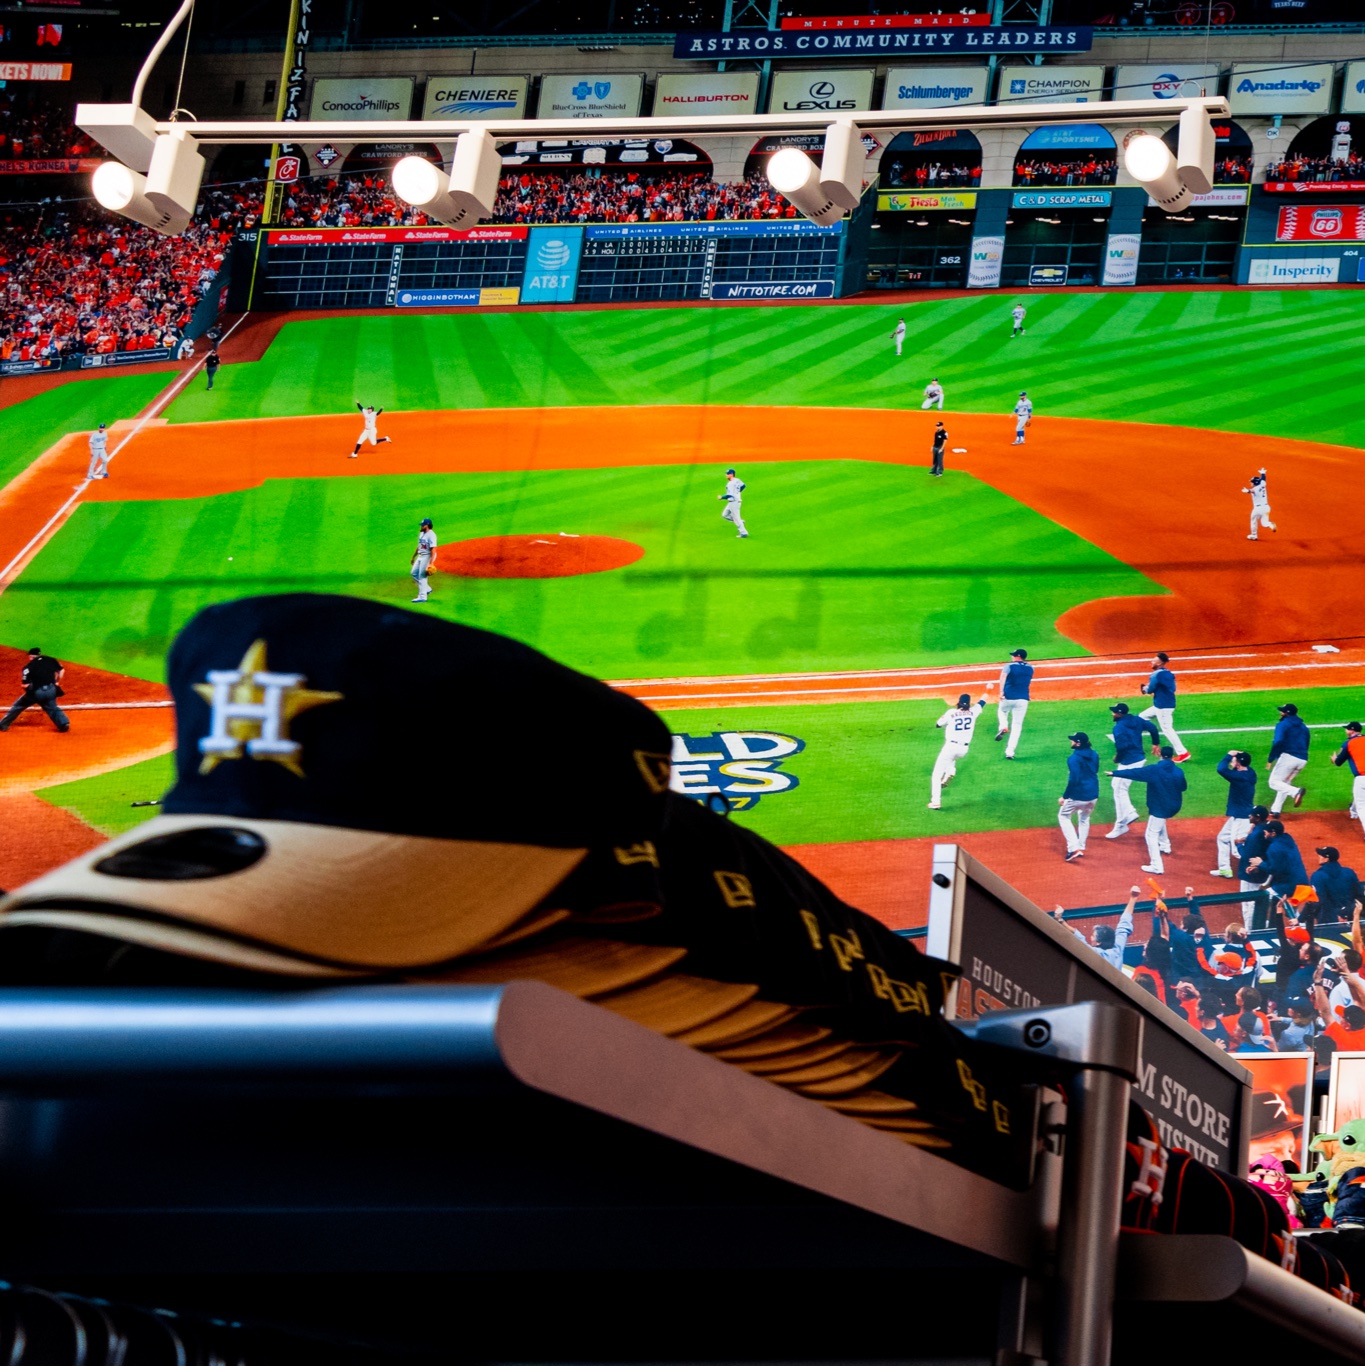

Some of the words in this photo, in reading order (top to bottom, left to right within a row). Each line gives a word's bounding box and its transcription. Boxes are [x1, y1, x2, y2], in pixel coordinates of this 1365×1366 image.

[804, 18, 892, 28] MINUTE
[914, 16, 970, 26] MAID
[690, 36, 783, 51] ASTROS
[796, 32, 955, 49] COMMUNITY
[966, 31, 1077, 46] LEADERS
[30, 63, 63, 80] NOW!
[1027, 79, 1091, 89] CHAMPION
[1152, 83, 1181, 91] OXY
[1236, 79, 1321, 93] Anadarko
[434, 89, 519, 102] CHENIERE
[662, 94, 749, 103] HALLIBURTON
[898, 85, 973, 101] Schlumberger
[322, 98, 400, 113] ConocoPhillips
[552, 103, 587, 111] BlueCross
[588, 103, 626, 111] BlueShield
[783, 100, 856, 111] LEXUS
[780, 136, 819, 144] LANDRY'S
[1052, 136, 1101, 144] SPORTSNET
[910, 196, 939, 208] Fiesta
[1019, 195, 1028, 205] C
[1037, 195, 1046, 205] D
[1049, 194, 1076, 204] SCRAP
[1078, 194, 1105, 204] METAL
[1315, 218, 1337, 232] 66
[238, 233, 258, 242] 315
[940, 256, 961, 264] 362
[388, 247, 400, 302] NATIONAL
[702, 241, 715, 295] AMERICAN
[1272, 264, 1335, 280] Insperity
[529, 275, 570, 289] AT&T
[728, 284, 817, 298] NITTOTIRE.COM
[412, 294, 477, 302] HIGGINBOTHAM
[954, 717, 972, 731] 22
[1161, 1075, 1231, 1148] STORE
